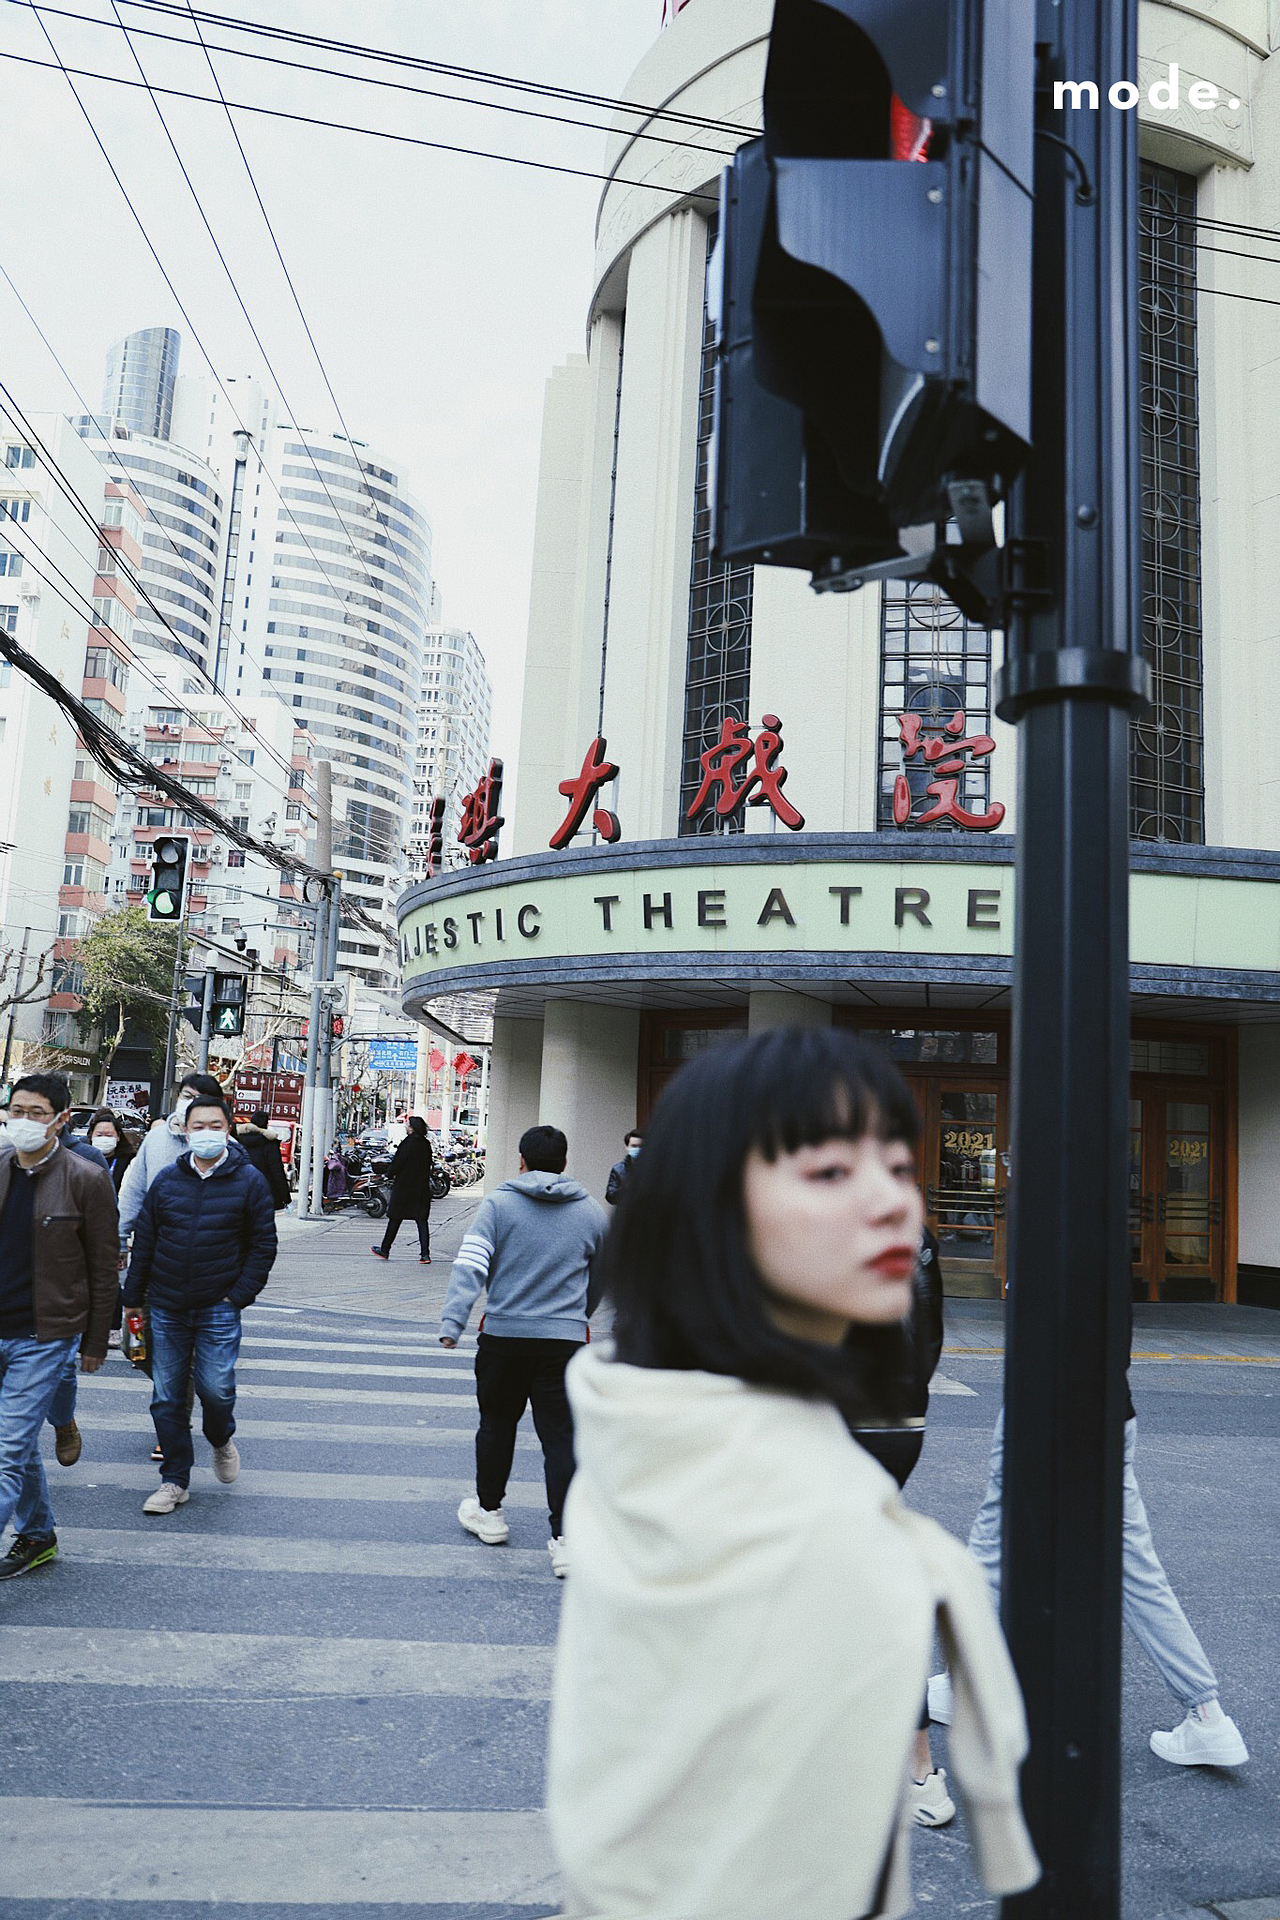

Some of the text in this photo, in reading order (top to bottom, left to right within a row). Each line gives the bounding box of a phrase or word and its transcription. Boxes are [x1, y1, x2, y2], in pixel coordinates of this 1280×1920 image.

[594, 886, 1001, 932] THEATRE
[944, 1130, 993, 1150] 2021
[1169, 1139, 1208, 1158] 2021
